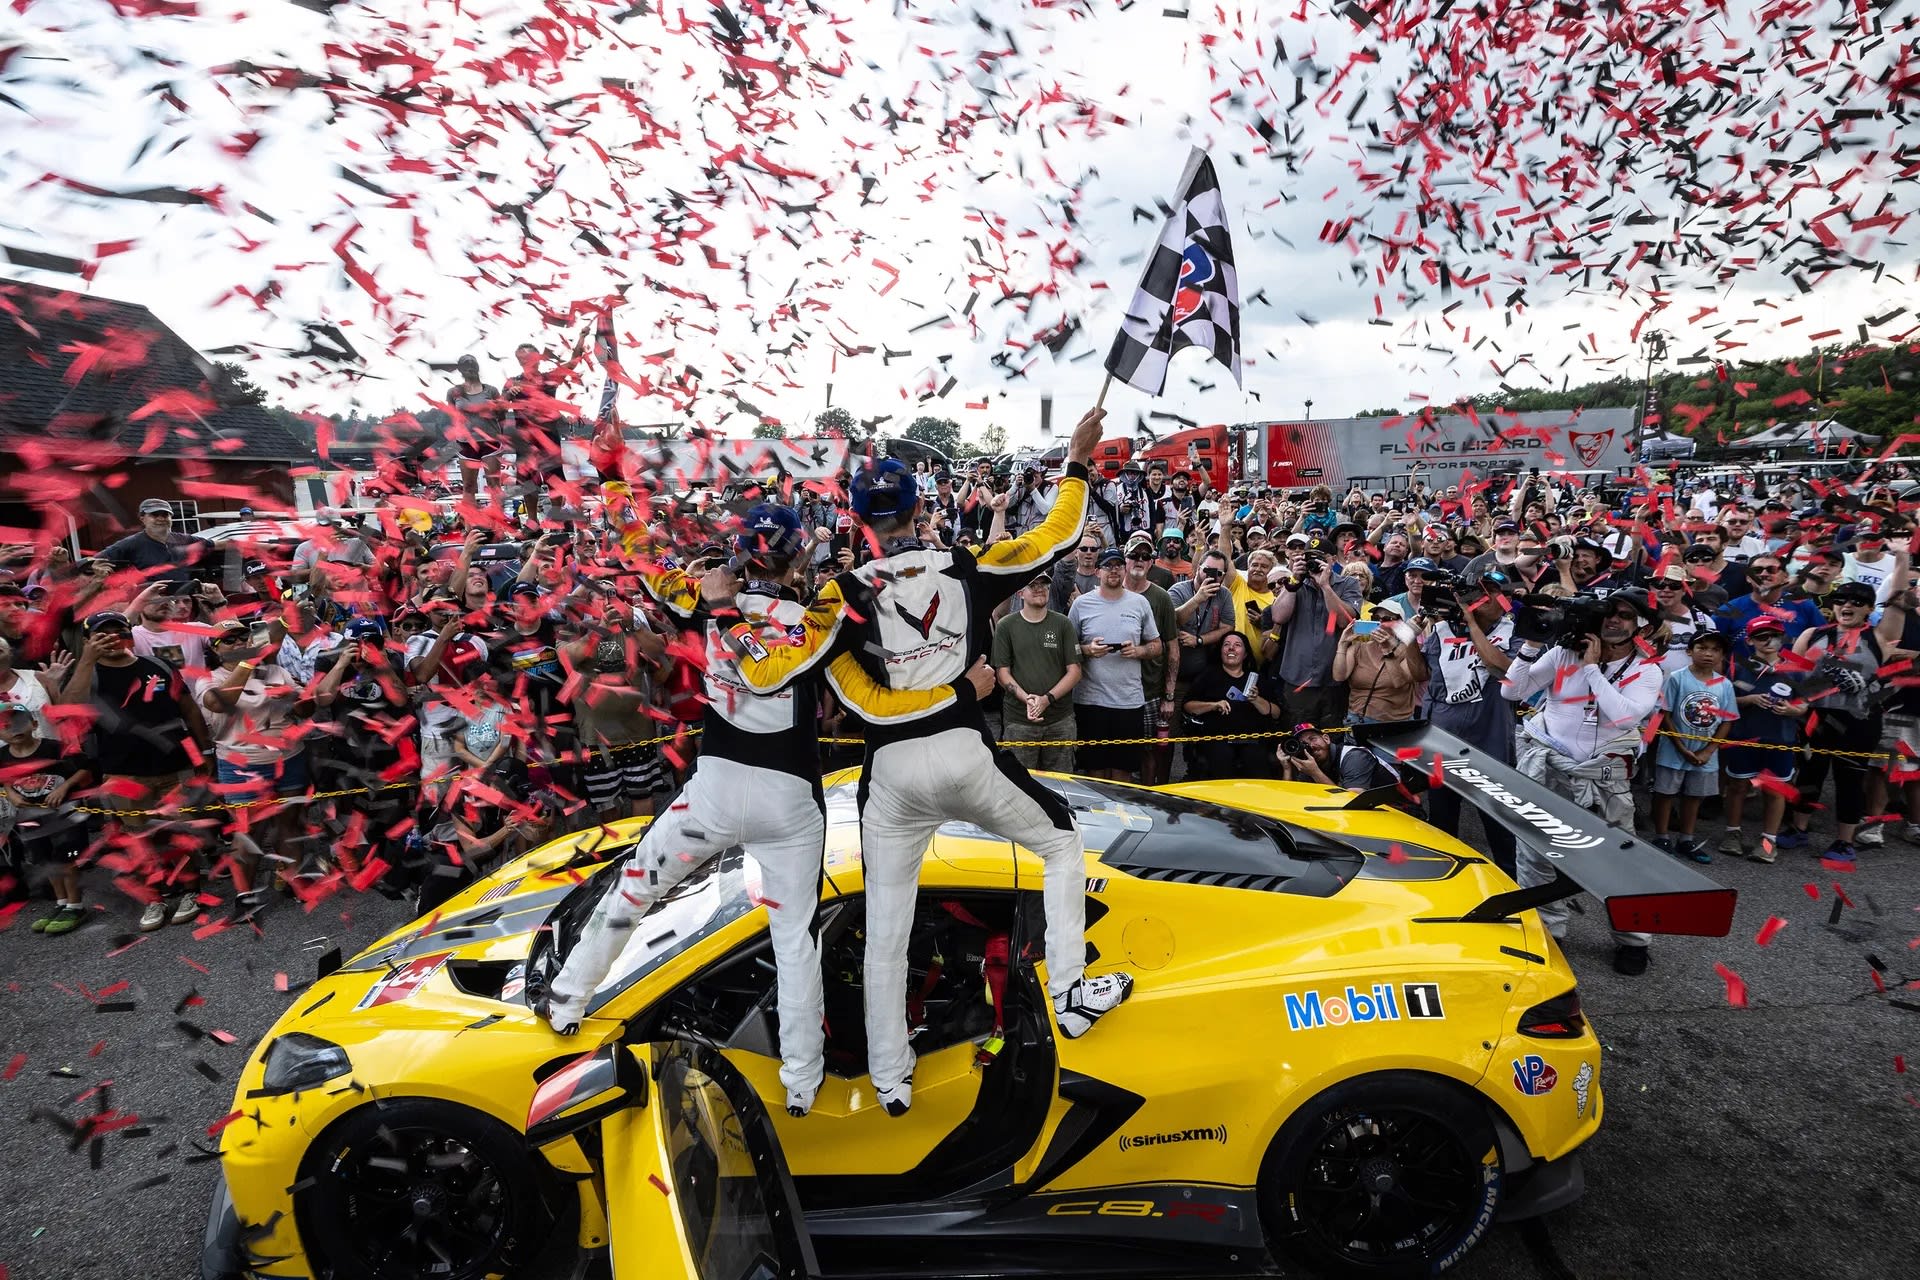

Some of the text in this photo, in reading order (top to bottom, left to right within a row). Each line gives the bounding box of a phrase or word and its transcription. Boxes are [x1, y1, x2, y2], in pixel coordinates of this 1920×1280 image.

[1284, 984, 1401, 1031] Mobil
[1512, 1055, 1545, 1096] VP
[1047, 1200, 1227, 1225] C8.R
